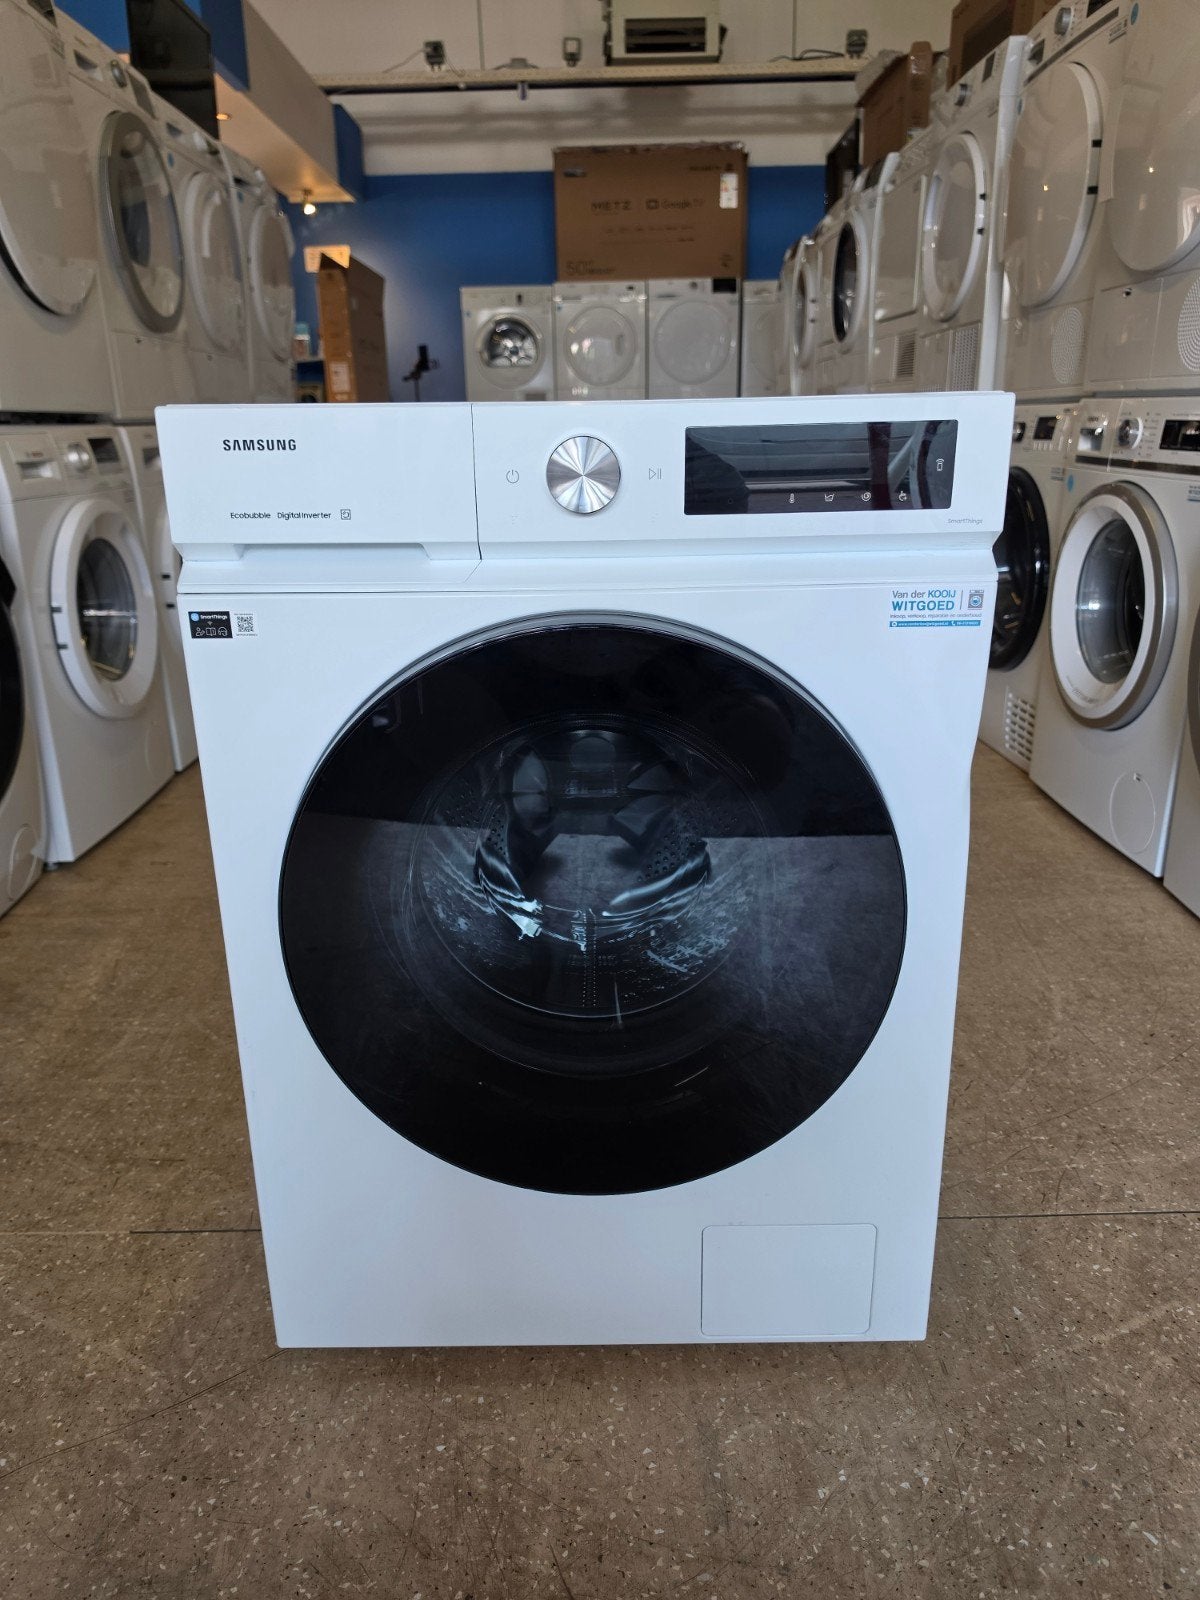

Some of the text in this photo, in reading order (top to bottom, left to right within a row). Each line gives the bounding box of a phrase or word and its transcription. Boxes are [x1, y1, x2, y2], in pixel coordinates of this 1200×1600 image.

[223, 439, 297, 451] SAMSUNG
[230, 511, 271, 519] Ecobubble
[892, 589, 956, 599] Van der KOOIJ
[892, 600, 955, 611] WITGOED
[200, 613, 228, 621] SmartThings
